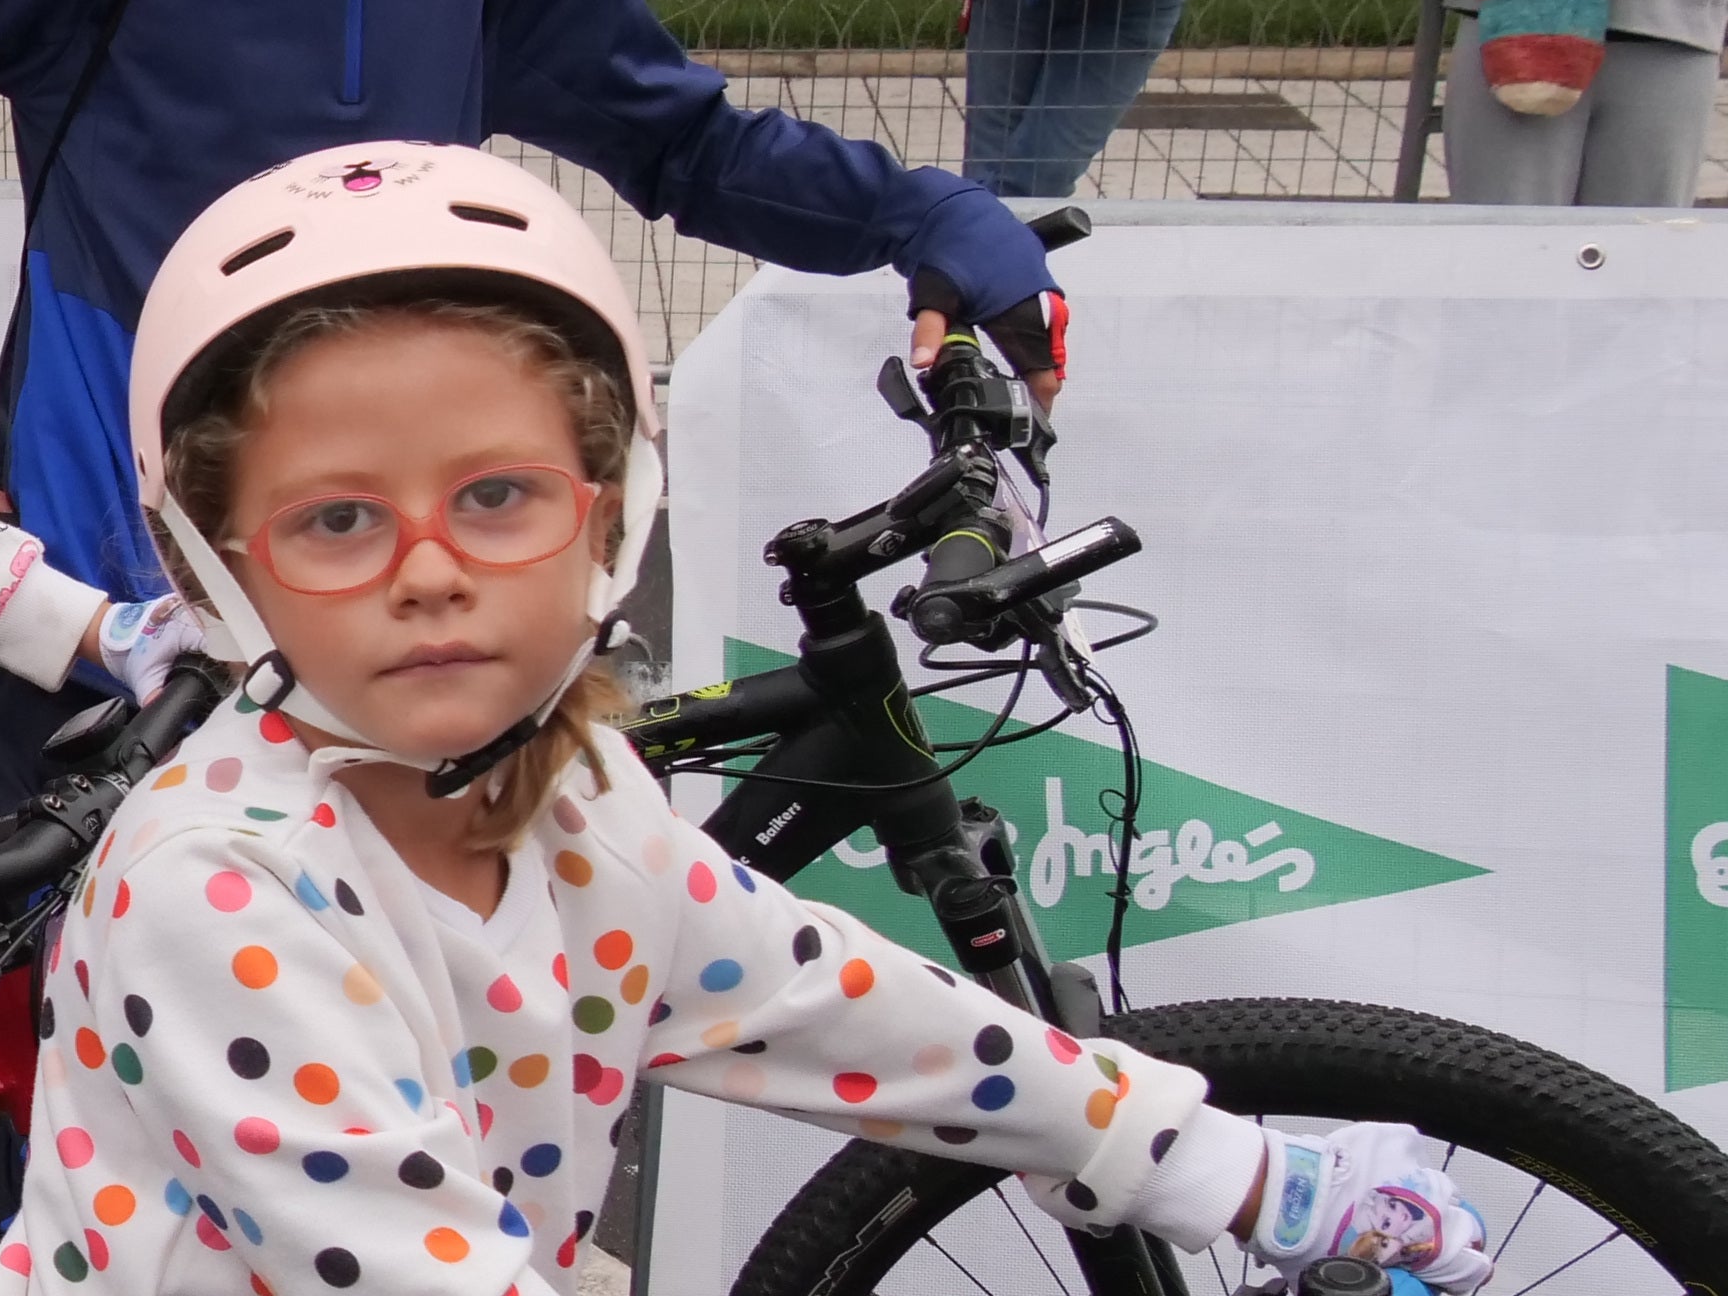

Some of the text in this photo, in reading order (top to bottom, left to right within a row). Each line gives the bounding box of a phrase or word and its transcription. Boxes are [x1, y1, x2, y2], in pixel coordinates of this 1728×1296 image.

[754, 801, 803, 847] Baikers
[1029, 776, 1315, 910] Inglés
[1289, 1176, 1307, 1221] FROZEN
